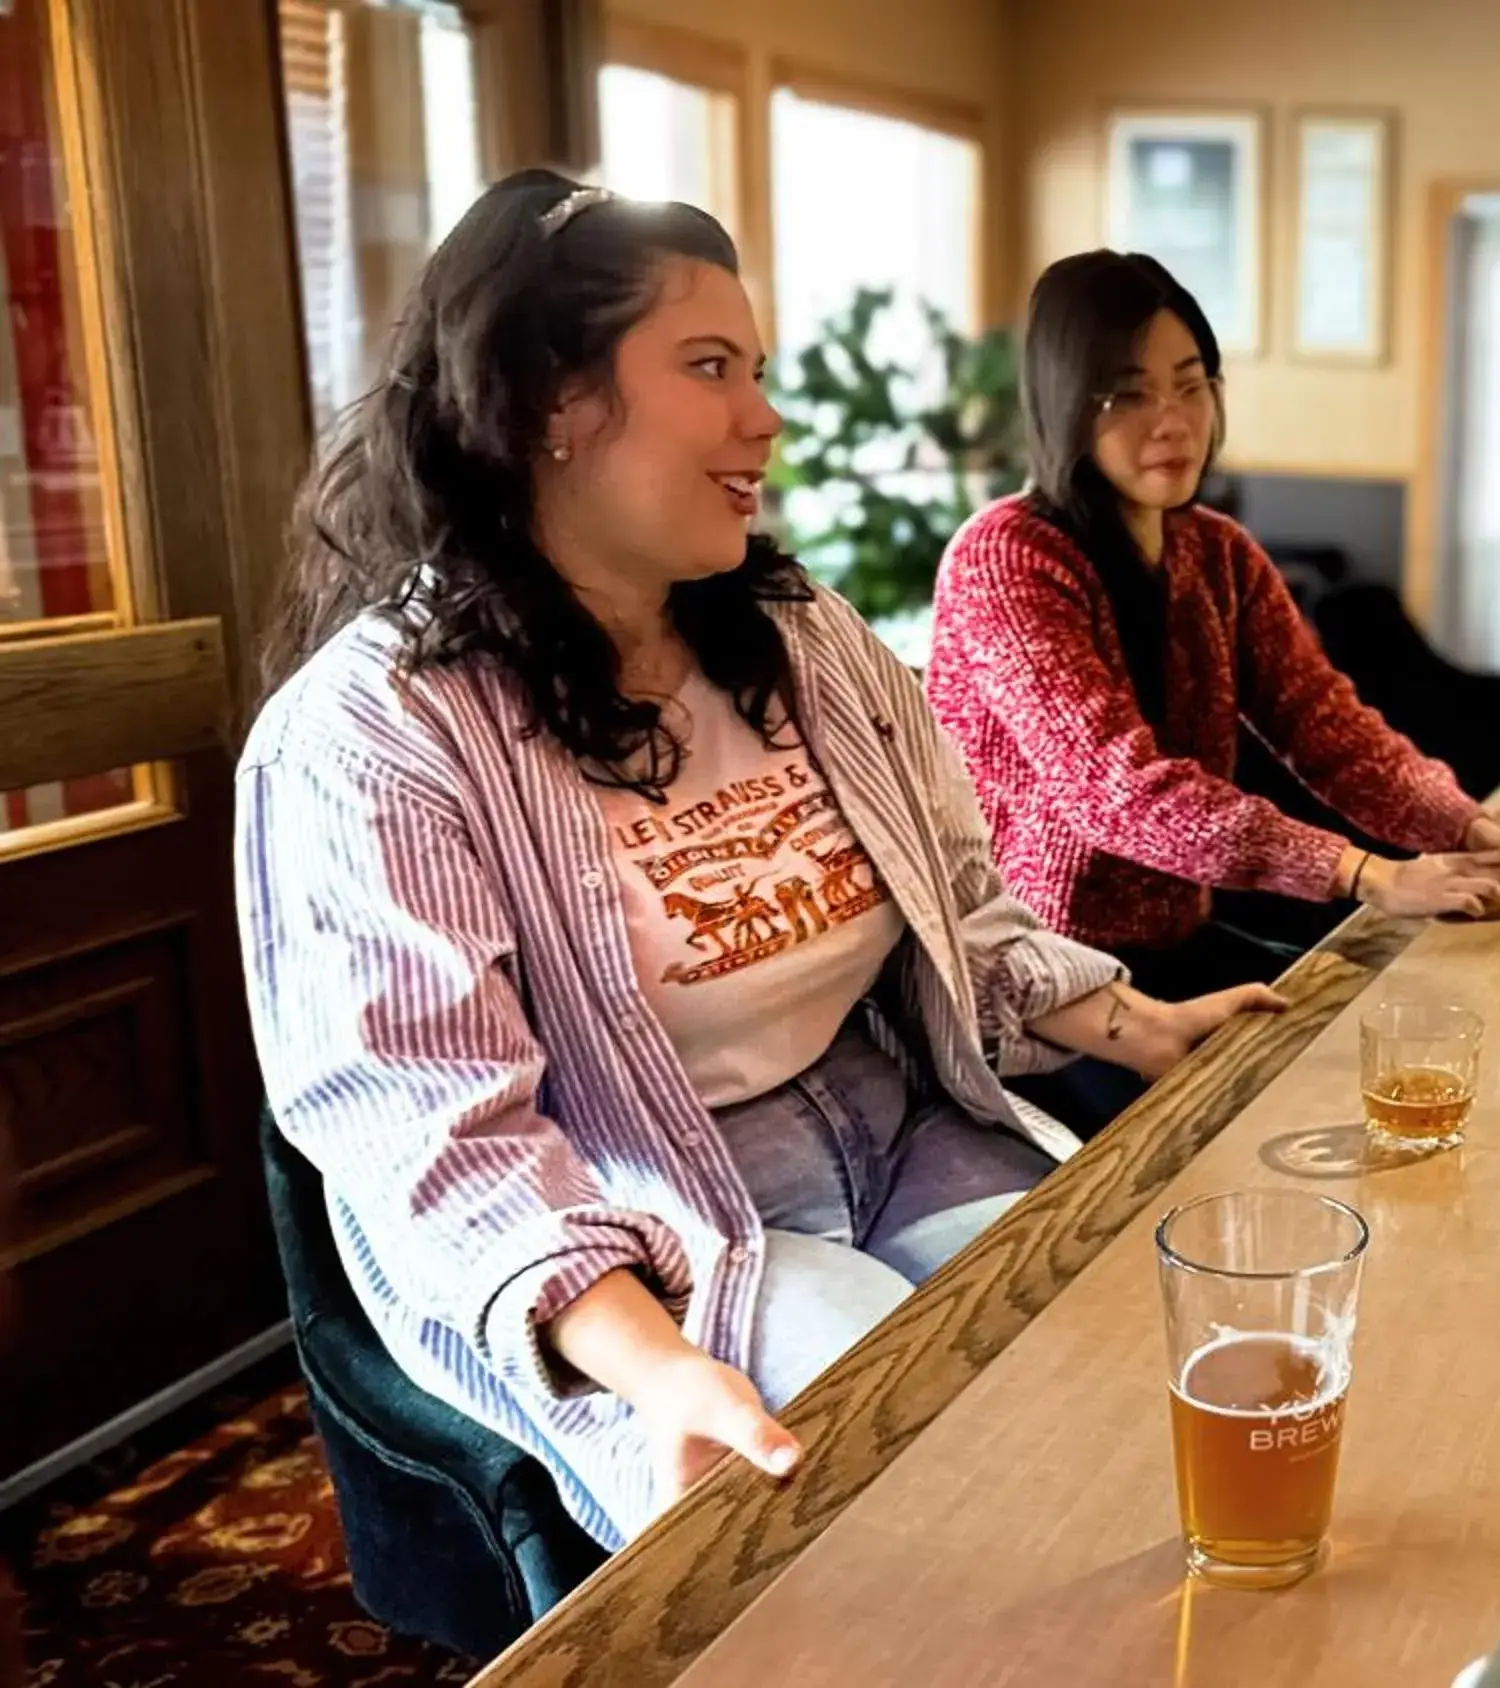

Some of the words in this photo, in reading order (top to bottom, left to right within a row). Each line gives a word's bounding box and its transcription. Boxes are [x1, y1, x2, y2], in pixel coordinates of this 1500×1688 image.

[671, 775, 786, 836] STRAUSS
[783, 763, 808, 789] &
[1250, 1411, 1339, 1452] BREW
